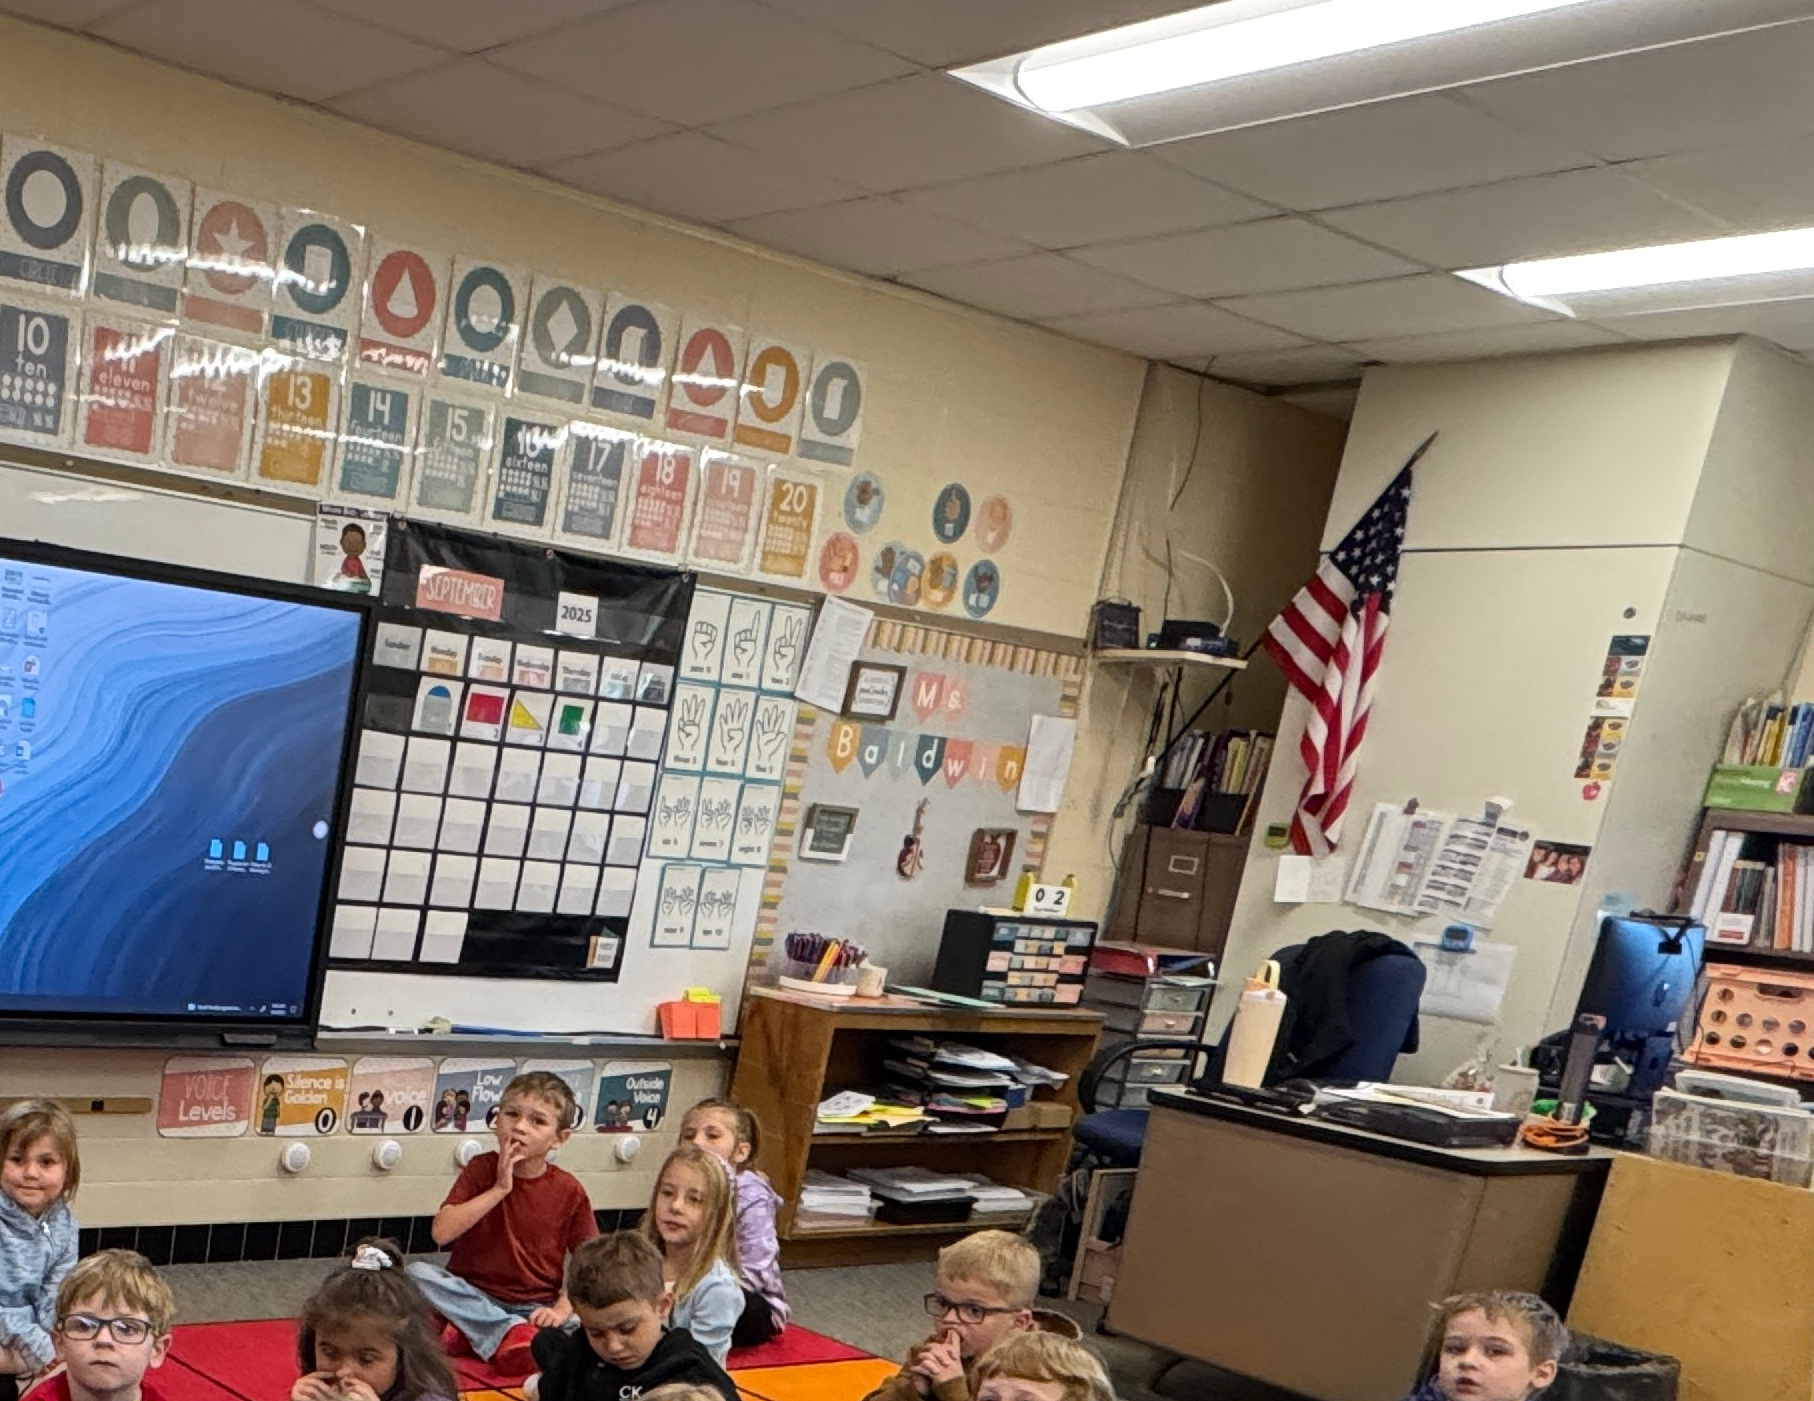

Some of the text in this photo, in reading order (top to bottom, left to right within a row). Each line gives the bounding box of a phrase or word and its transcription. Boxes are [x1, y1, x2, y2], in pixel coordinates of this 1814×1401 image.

[17, 313, 50, 355] 10
[15, 352, 48, 376] ten
[99, 369, 151, 391] eleven
[288, 373, 313, 411] 13
[368, 390, 392, 425] 14
[446, 407, 469, 443] 15
[588, 440, 612, 473] 17
[656, 452, 676, 485] 18
[721, 465, 741, 498] 19
[779, 482, 808, 513] 20
[425, 572, 497, 611] SEPTEMBER
[561, 605, 592, 624] 2025
[836, 725, 1020, 779] Baldwin
[185, 1074, 233, 1101] VOICE
[286, 1073, 345, 1090] Silence is
[477, 1071, 502, 1086] Low
[625, 1076, 665, 1090] Outside
[179, 1101, 237, 1121] Levels
[286, 1090, 328, 1105] Golden
[634, 1091, 661, 1104] Voice
[647, 1107, 658, 1126] 4
